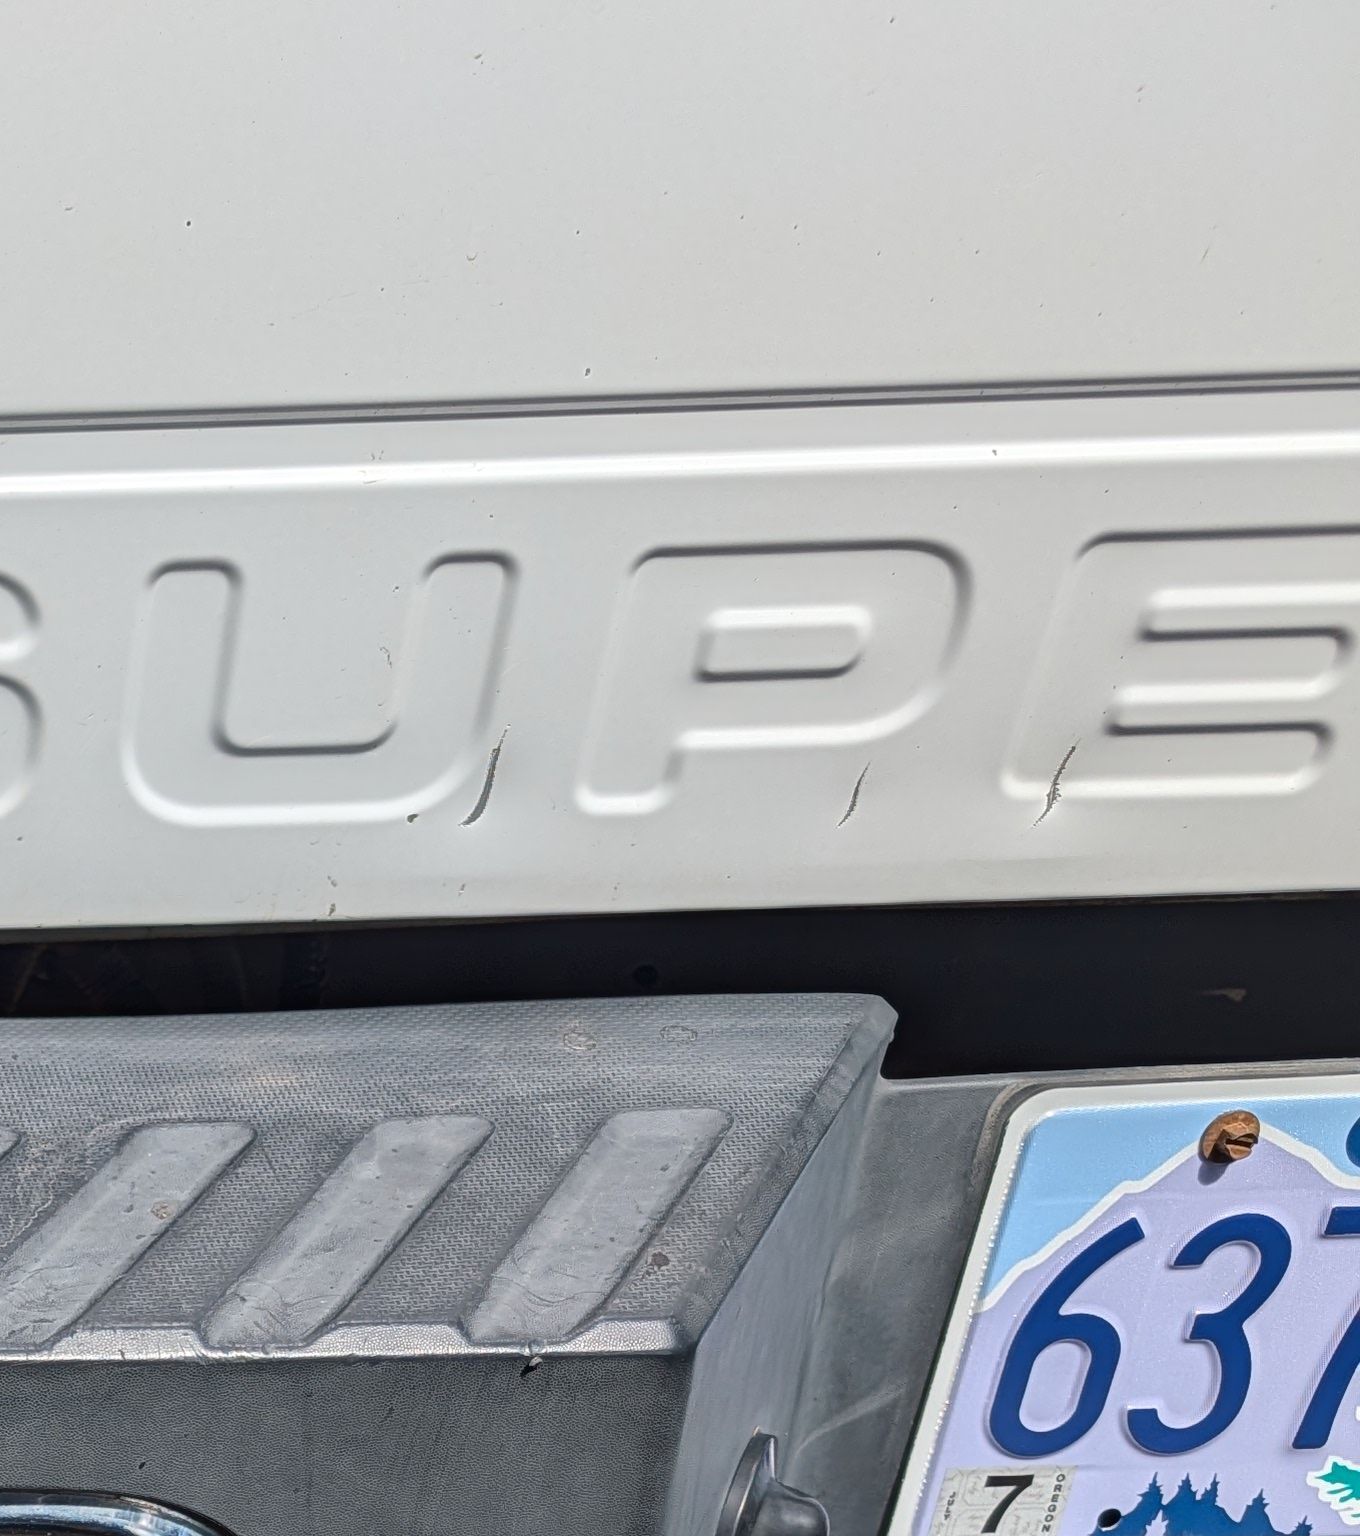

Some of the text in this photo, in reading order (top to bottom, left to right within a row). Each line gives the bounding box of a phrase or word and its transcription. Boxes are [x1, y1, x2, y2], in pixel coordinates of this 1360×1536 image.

[943, 1491, 957, 1521] JULY
[980, 1474, 1035, 1534] 7
[1041, 1473, 1066, 1533] OREGON
